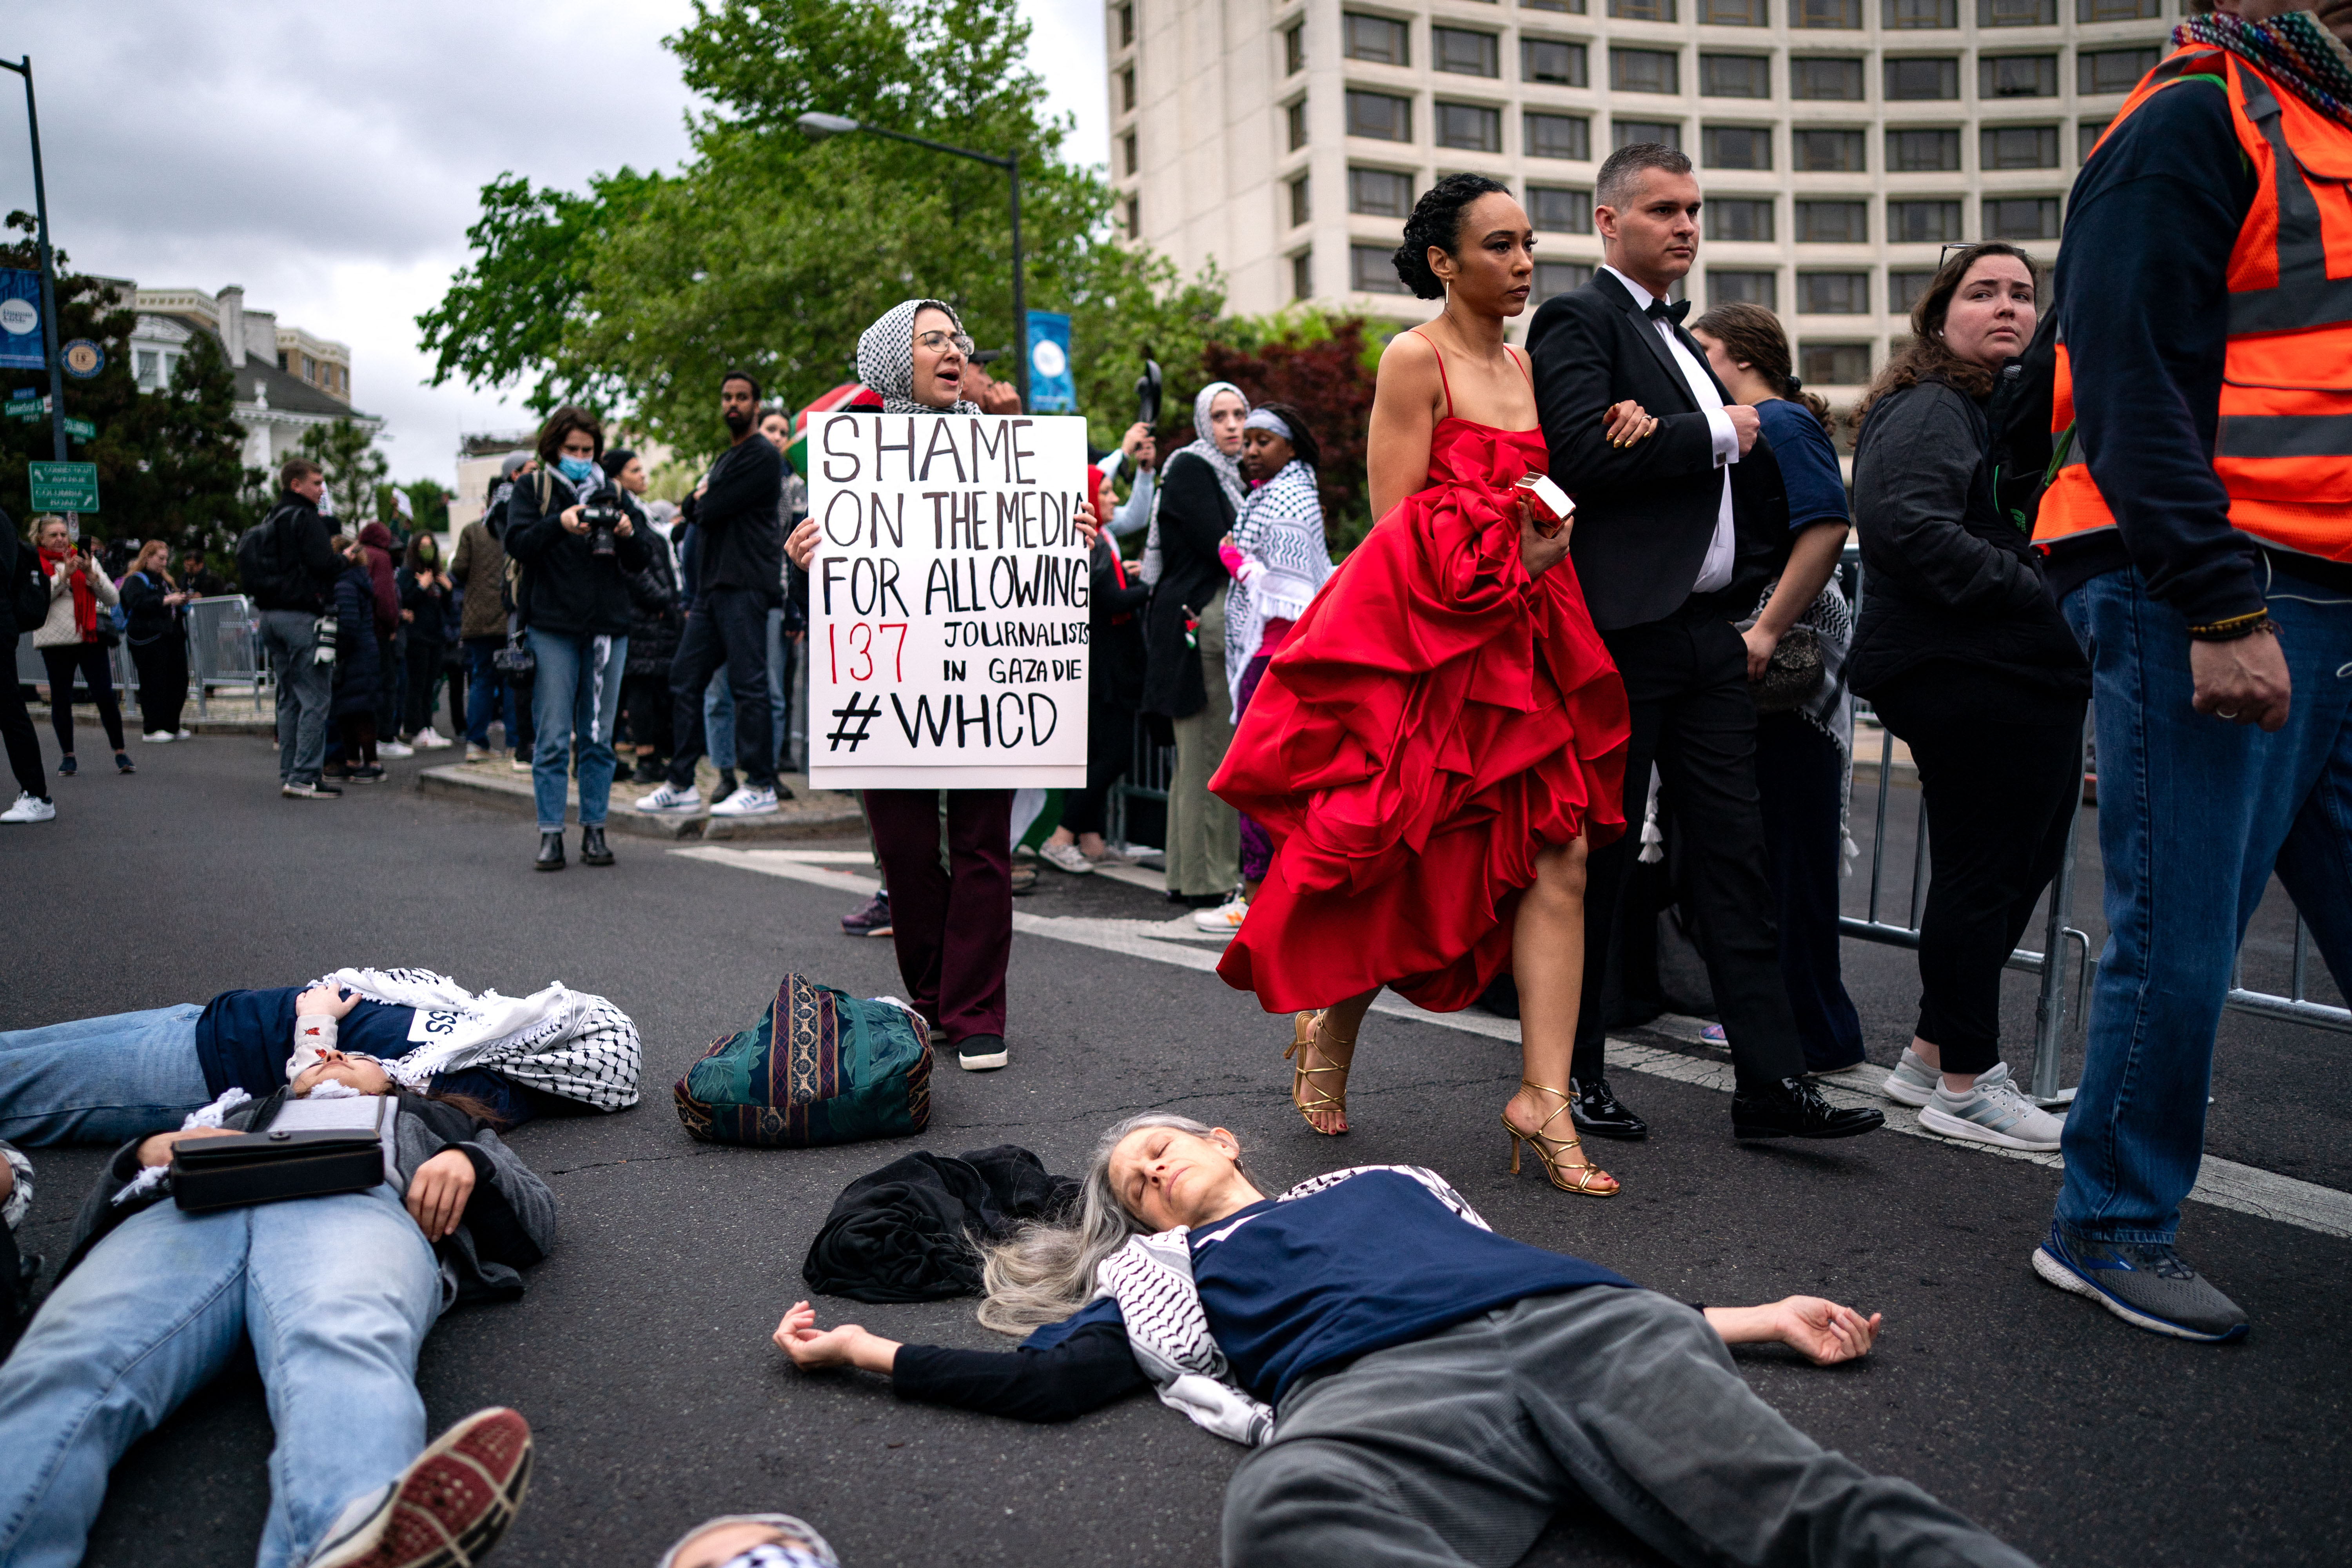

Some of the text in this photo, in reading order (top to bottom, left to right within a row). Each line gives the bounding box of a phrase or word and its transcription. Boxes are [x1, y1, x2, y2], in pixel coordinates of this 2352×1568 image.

[824, 415, 1036, 484] SHAME
[825, 490, 1087, 550] ON THE MEDIA
[823, 554, 1088, 617] FOR ALLOWING
[830, 621, 1089, 684] 137 JOURNALISTS
[944, 658, 1081, 684] IN GAZA DIE
[827, 691, 1057, 752] #WHCD
